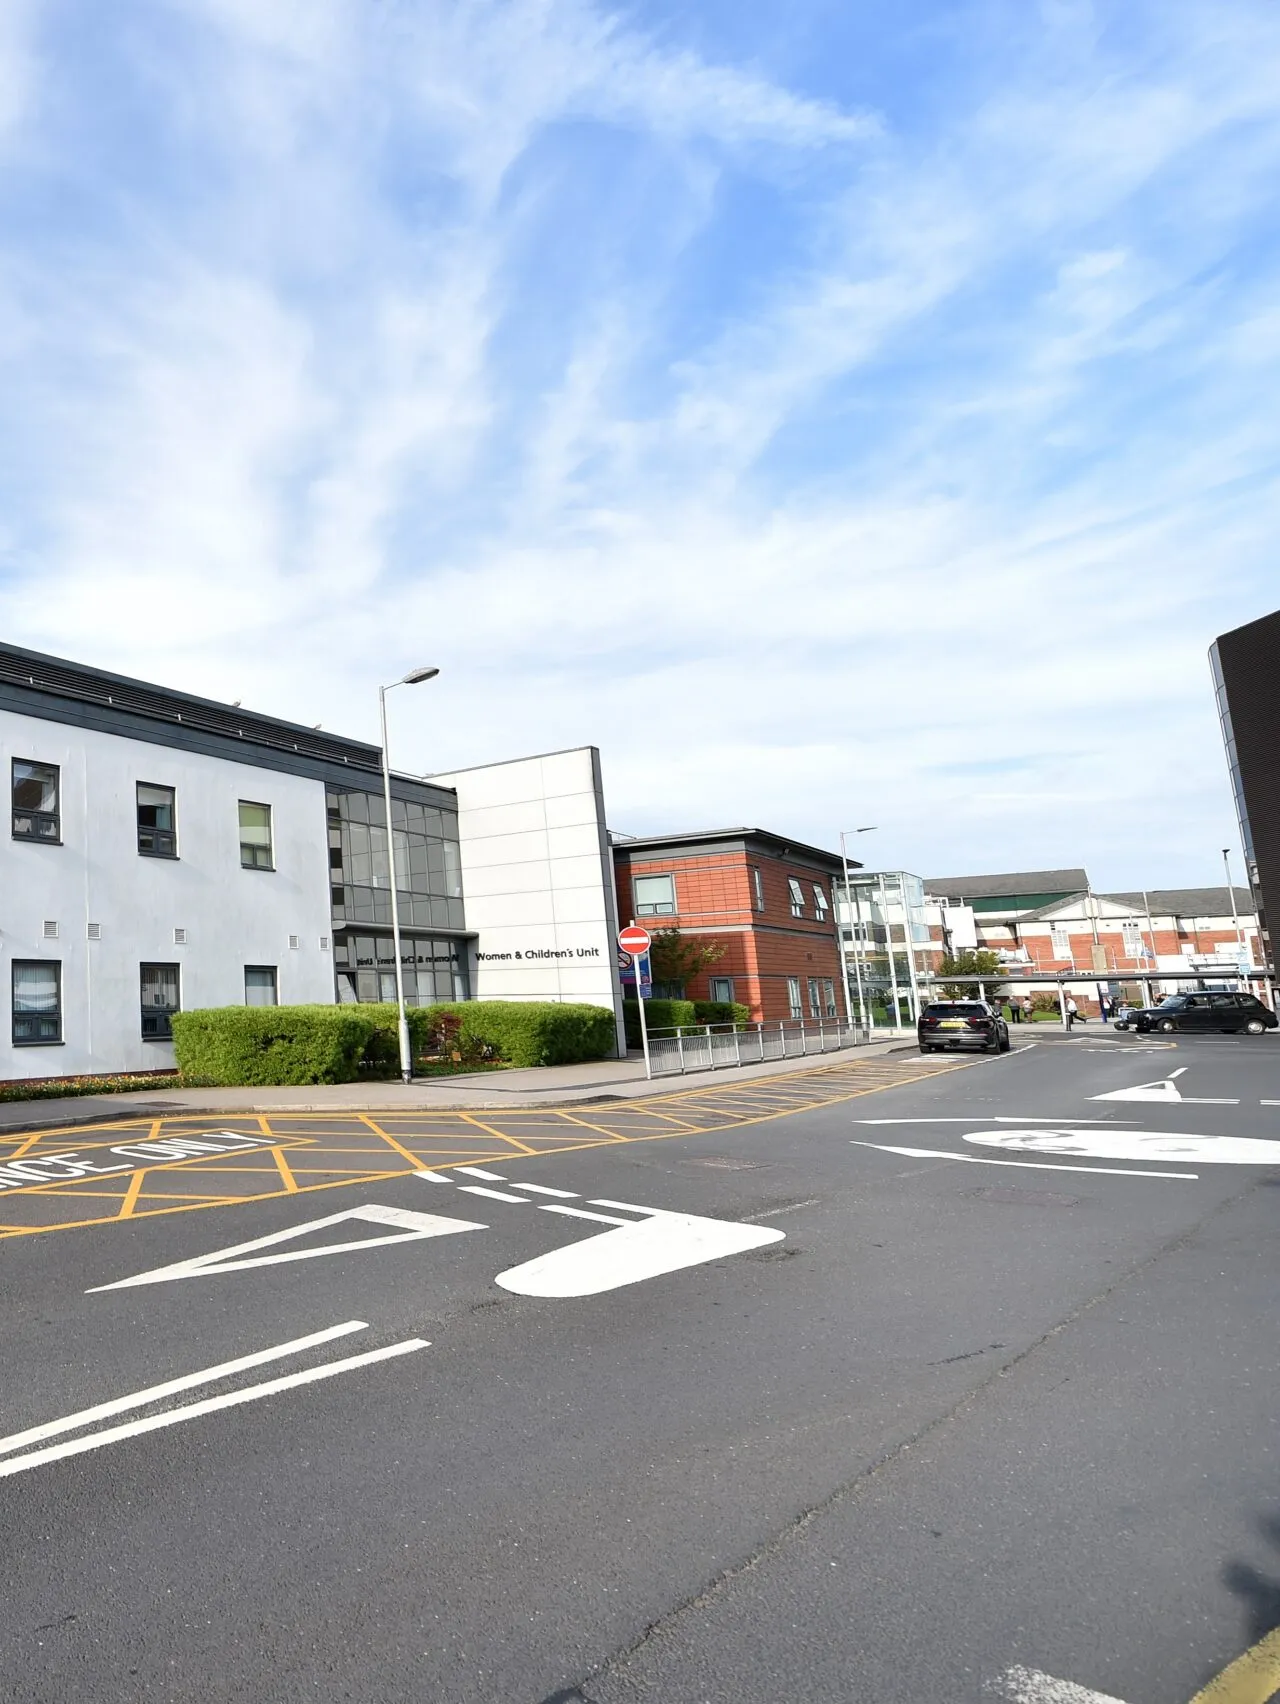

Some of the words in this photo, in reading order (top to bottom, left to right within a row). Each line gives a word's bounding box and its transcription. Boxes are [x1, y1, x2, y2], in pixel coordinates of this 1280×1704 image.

[475, 951, 512, 961] Women
[514, 951, 523, 960] &
[524, 948, 574, 959] Children's
[576, 947, 600, 957] Unit
[109, 1130, 276, 1161] ONLY
